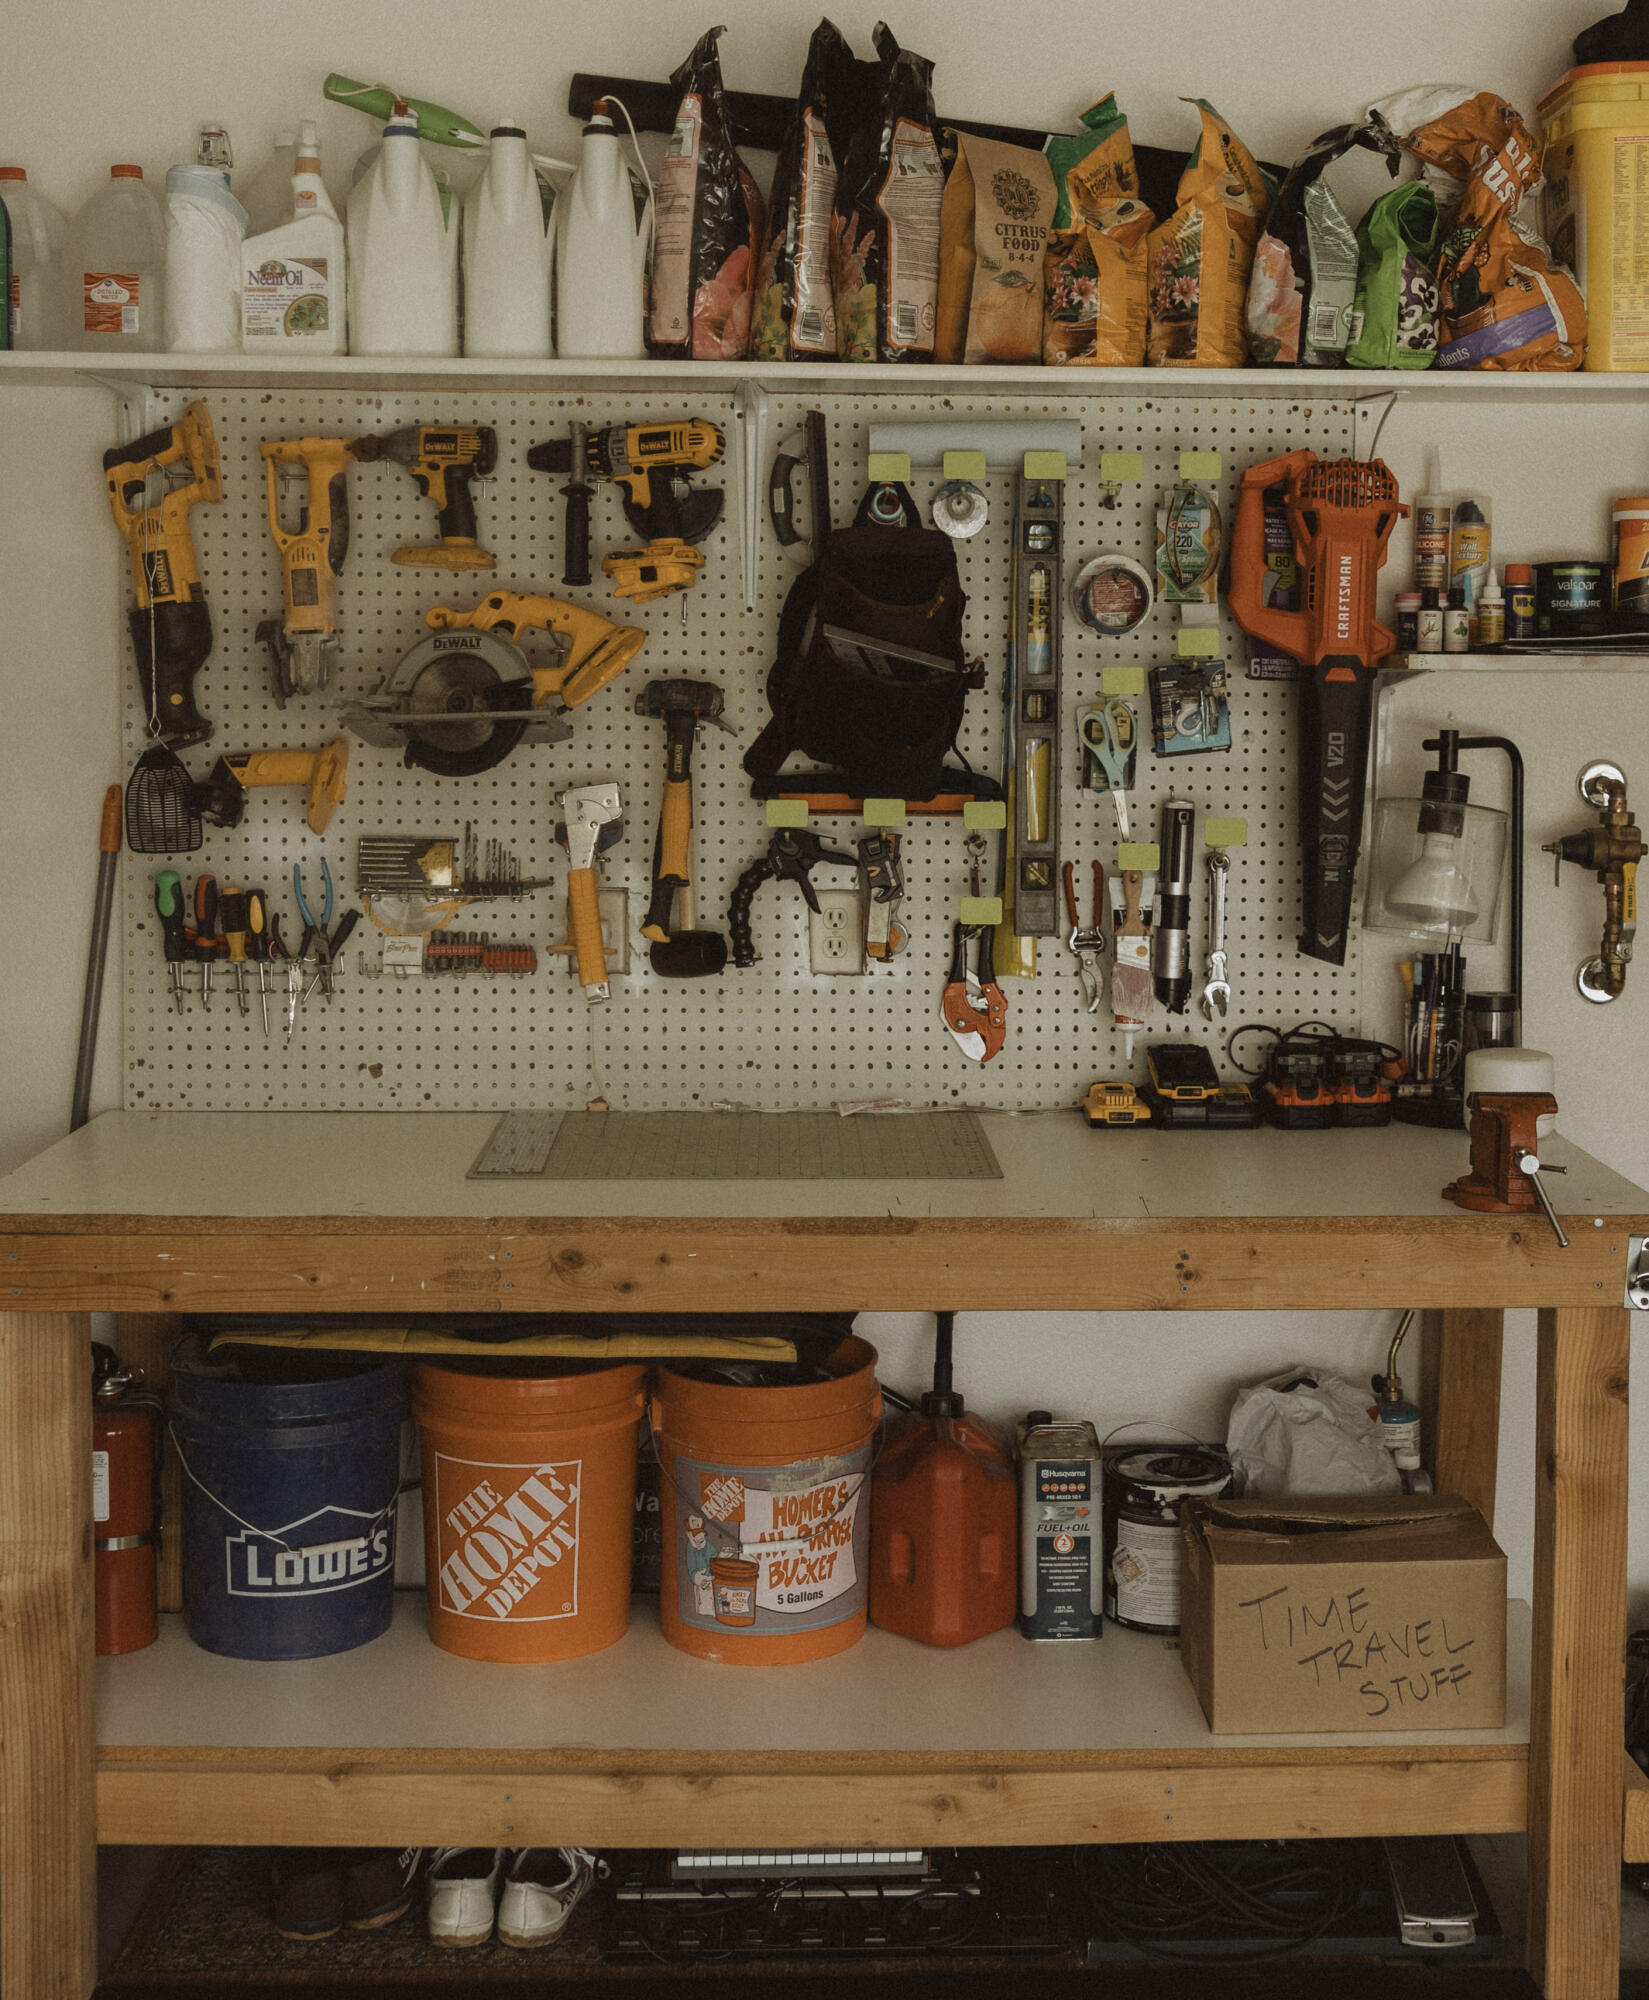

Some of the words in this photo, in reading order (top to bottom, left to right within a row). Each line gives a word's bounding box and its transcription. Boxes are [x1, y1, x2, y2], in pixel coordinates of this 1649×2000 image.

[995, 223, 1047, 239] CITRUS
[1002, 237, 1040, 251] FOOD
[1008, 252, 1035, 263] 8-4-4
[248, 270, 283, 286] Neem
[285, 270, 303, 286] Oil
[1176, 536, 1193, 548] 220
[1460, 542, 1478, 551] Wall
[1274, 556, 1291, 568] 80
[1456, 552, 1483, 560] Texture
[1557, 579, 1597, 592] valspar
[1336, 555, 1352, 640] CRAFTSMAN
[1551, 599, 1601, 608] SIGNATURE
[1250, 658, 1262, 678] 6
[1327, 732, 1345, 769] V20
[1049, 1469, 1086, 1478] Husqvarna
[704, 1478, 723, 1497] THE
[701, 1476, 745, 1520] HOME
[772, 1480, 851, 1531] HOMER'S
[444, 1480, 504, 1538] THE
[716, 1494, 745, 1522] DEPOT
[1036, 1523, 1091, 1533] FUEL+OIL
[440, 1464, 580, 1613] HOME
[1061, 1538, 1068, 1546] 2
[484, 1518, 578, 1619] DEPOT
[768, 1551, 838, 1590] BUCKET
[777, 1593, 784, 1606] 5
[787, 1590, 824, 1605] Gallons
[1239, 1586, 1370, 1650] TIME
[1297, 1618, 1475, 1687] TRAVEL
[1358, 1664, 1473, 1717] STUFF
